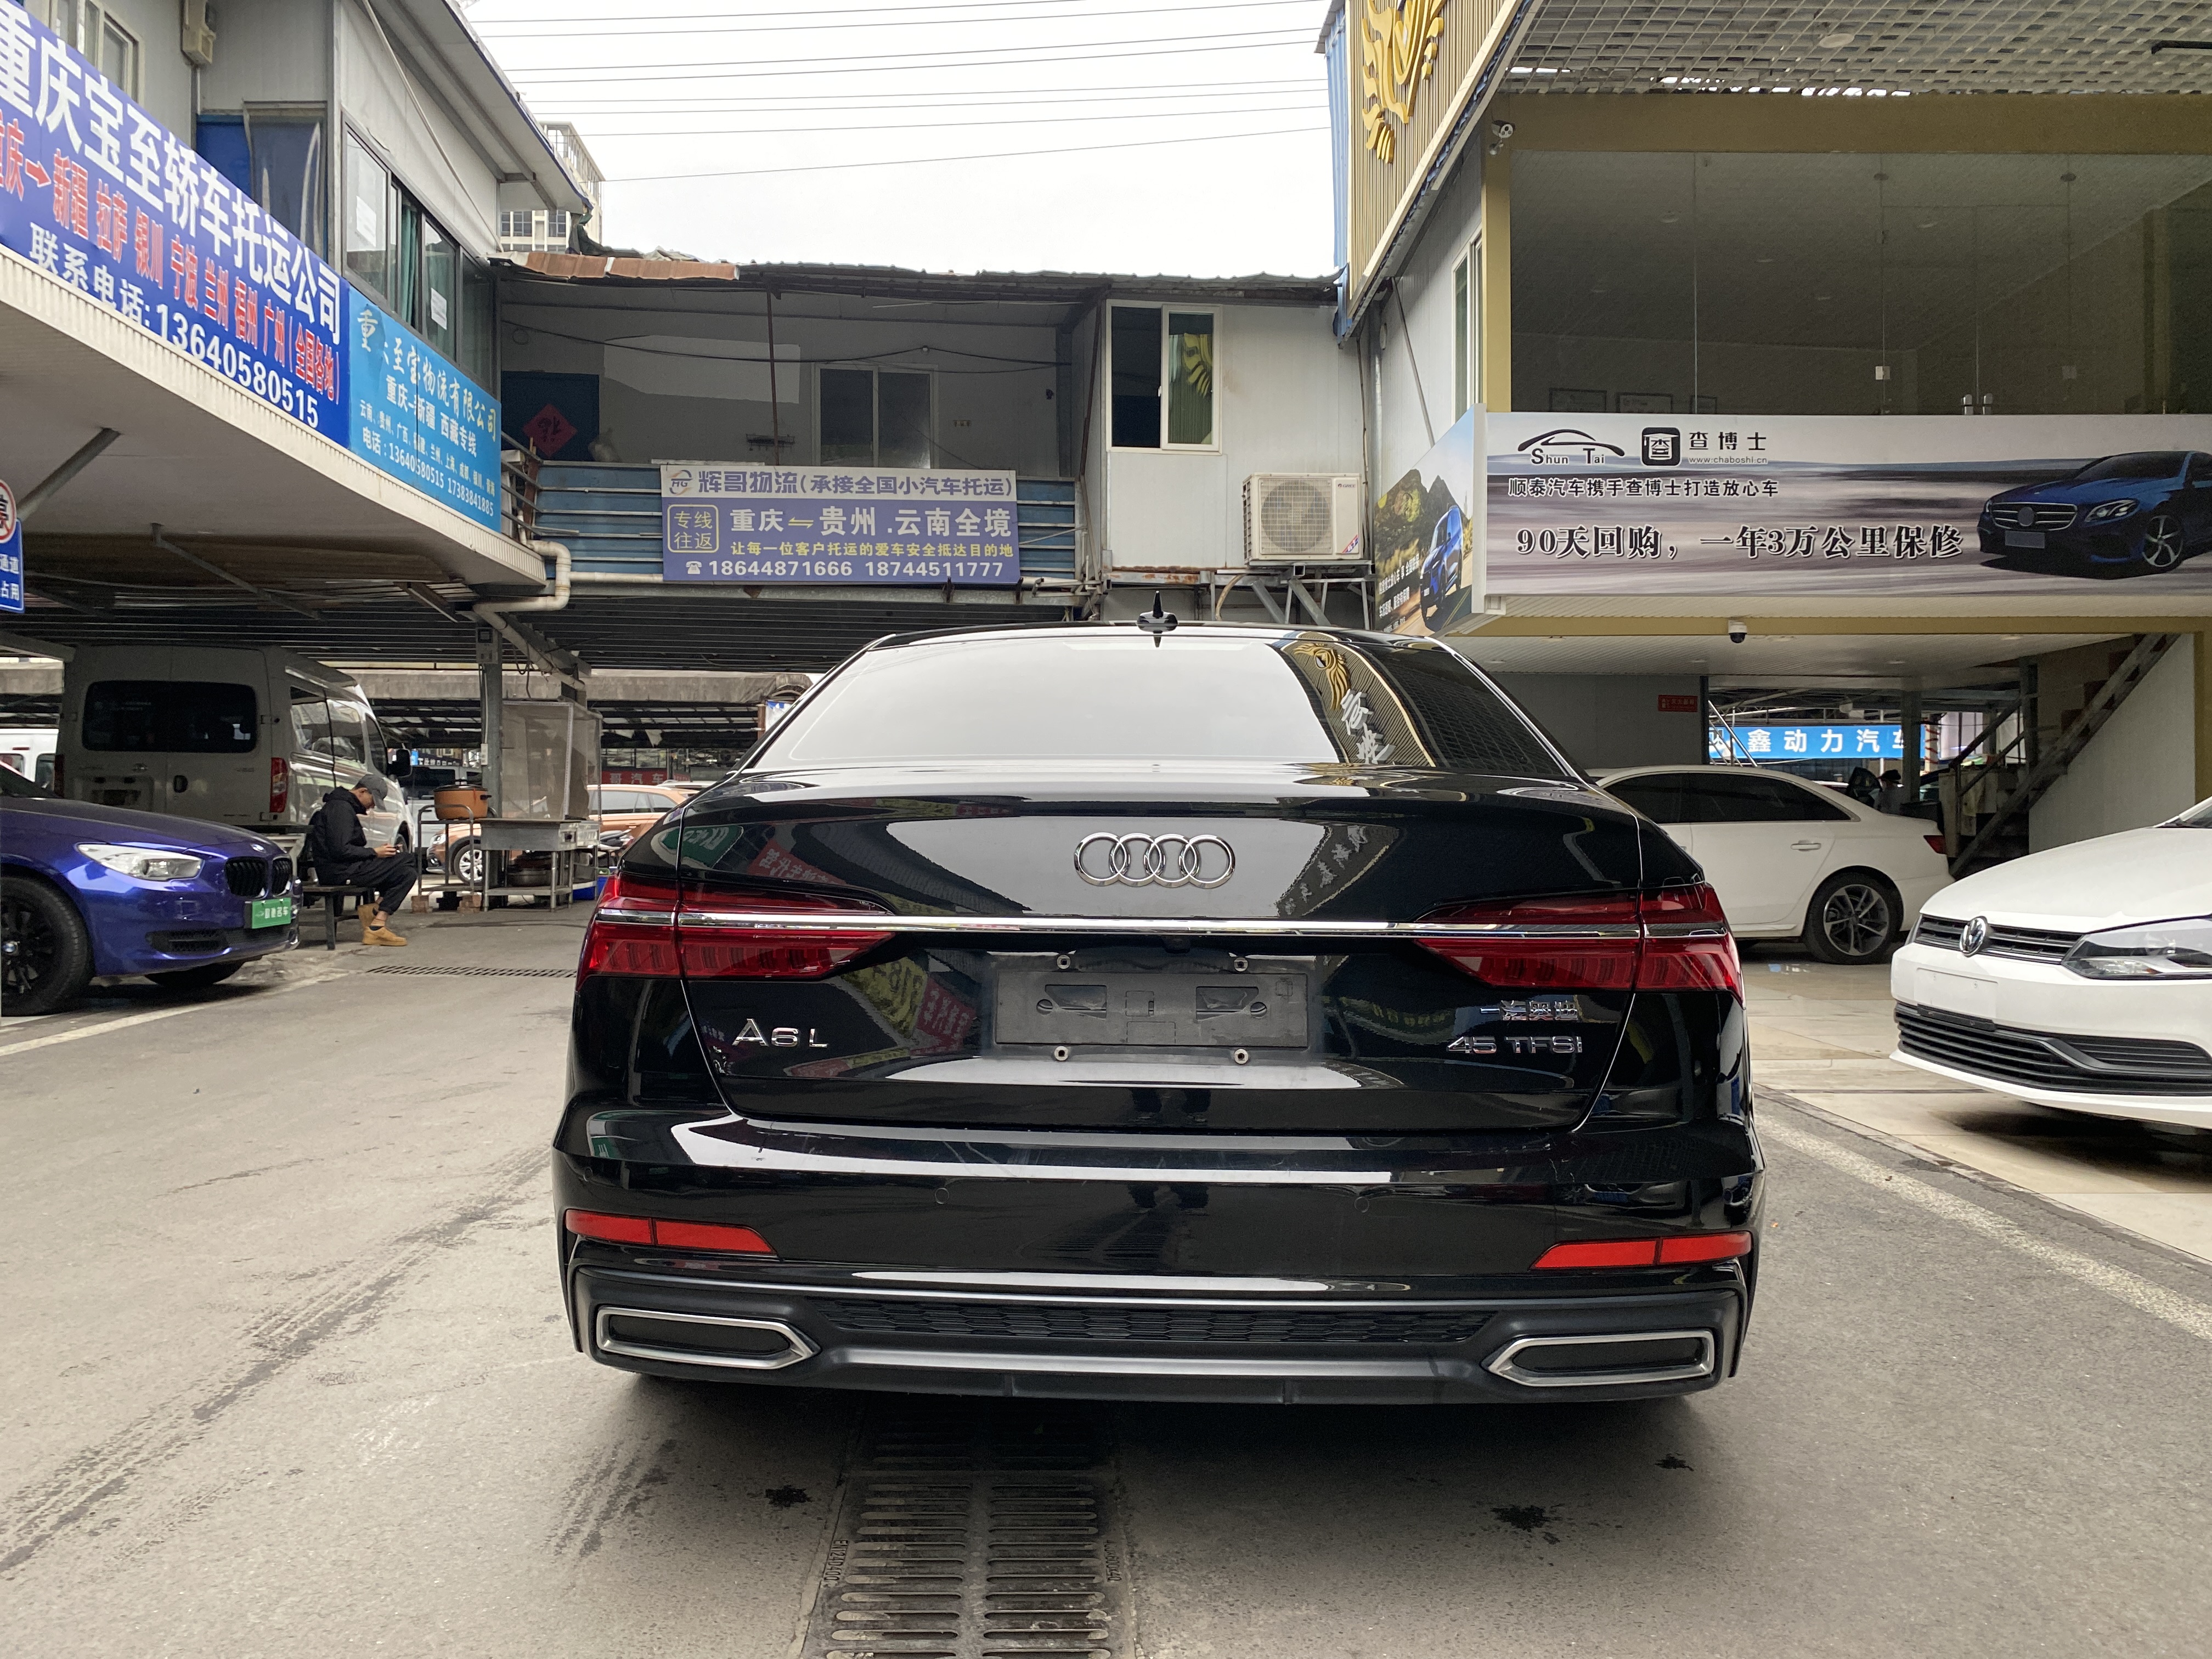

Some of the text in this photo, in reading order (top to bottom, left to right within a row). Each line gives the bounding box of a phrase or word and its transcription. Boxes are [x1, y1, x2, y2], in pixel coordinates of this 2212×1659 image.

[0, 1, 340, 345] 重庆宝至轿车托运公司
[0, 113, 25, 201] 庆
[53, 148, 89, 240] 新疆
[96, 178, 128, 263] 拉萨
[134, 206, 163, 289] 银川
[171, 234, 198, 311] 宁波
[204, 256, 229, 331] 兰州
[234, 276, 258, 349] 福州
[357, 309, 496, 442] 重至宝物流有限公司
[440, 411, 477, 458] 西藏专线
[1689, 431, 1768, 452] 查博士
[1530, 448, 1606, 465] Shun Tai
[1689, 455, 1768, 465] www.chaboshi.cn
[1508, 477, 1779, 498] 顺泰汽车携手查博士打造放心车
[674, 510, 713, 529] 专线
[730, 509, 784, 532] 重庆
[819, 506, 876, 536] 贵州
[674, 531, 713, 550] 往返
[731, 541, 1014, 557] 让每一位客户托运的爱车安全抵达目的地
[709, 560, 1003, 577] 18644871666 18744511777
[1446, 1036, 1583, 1054] 45 TFSI
